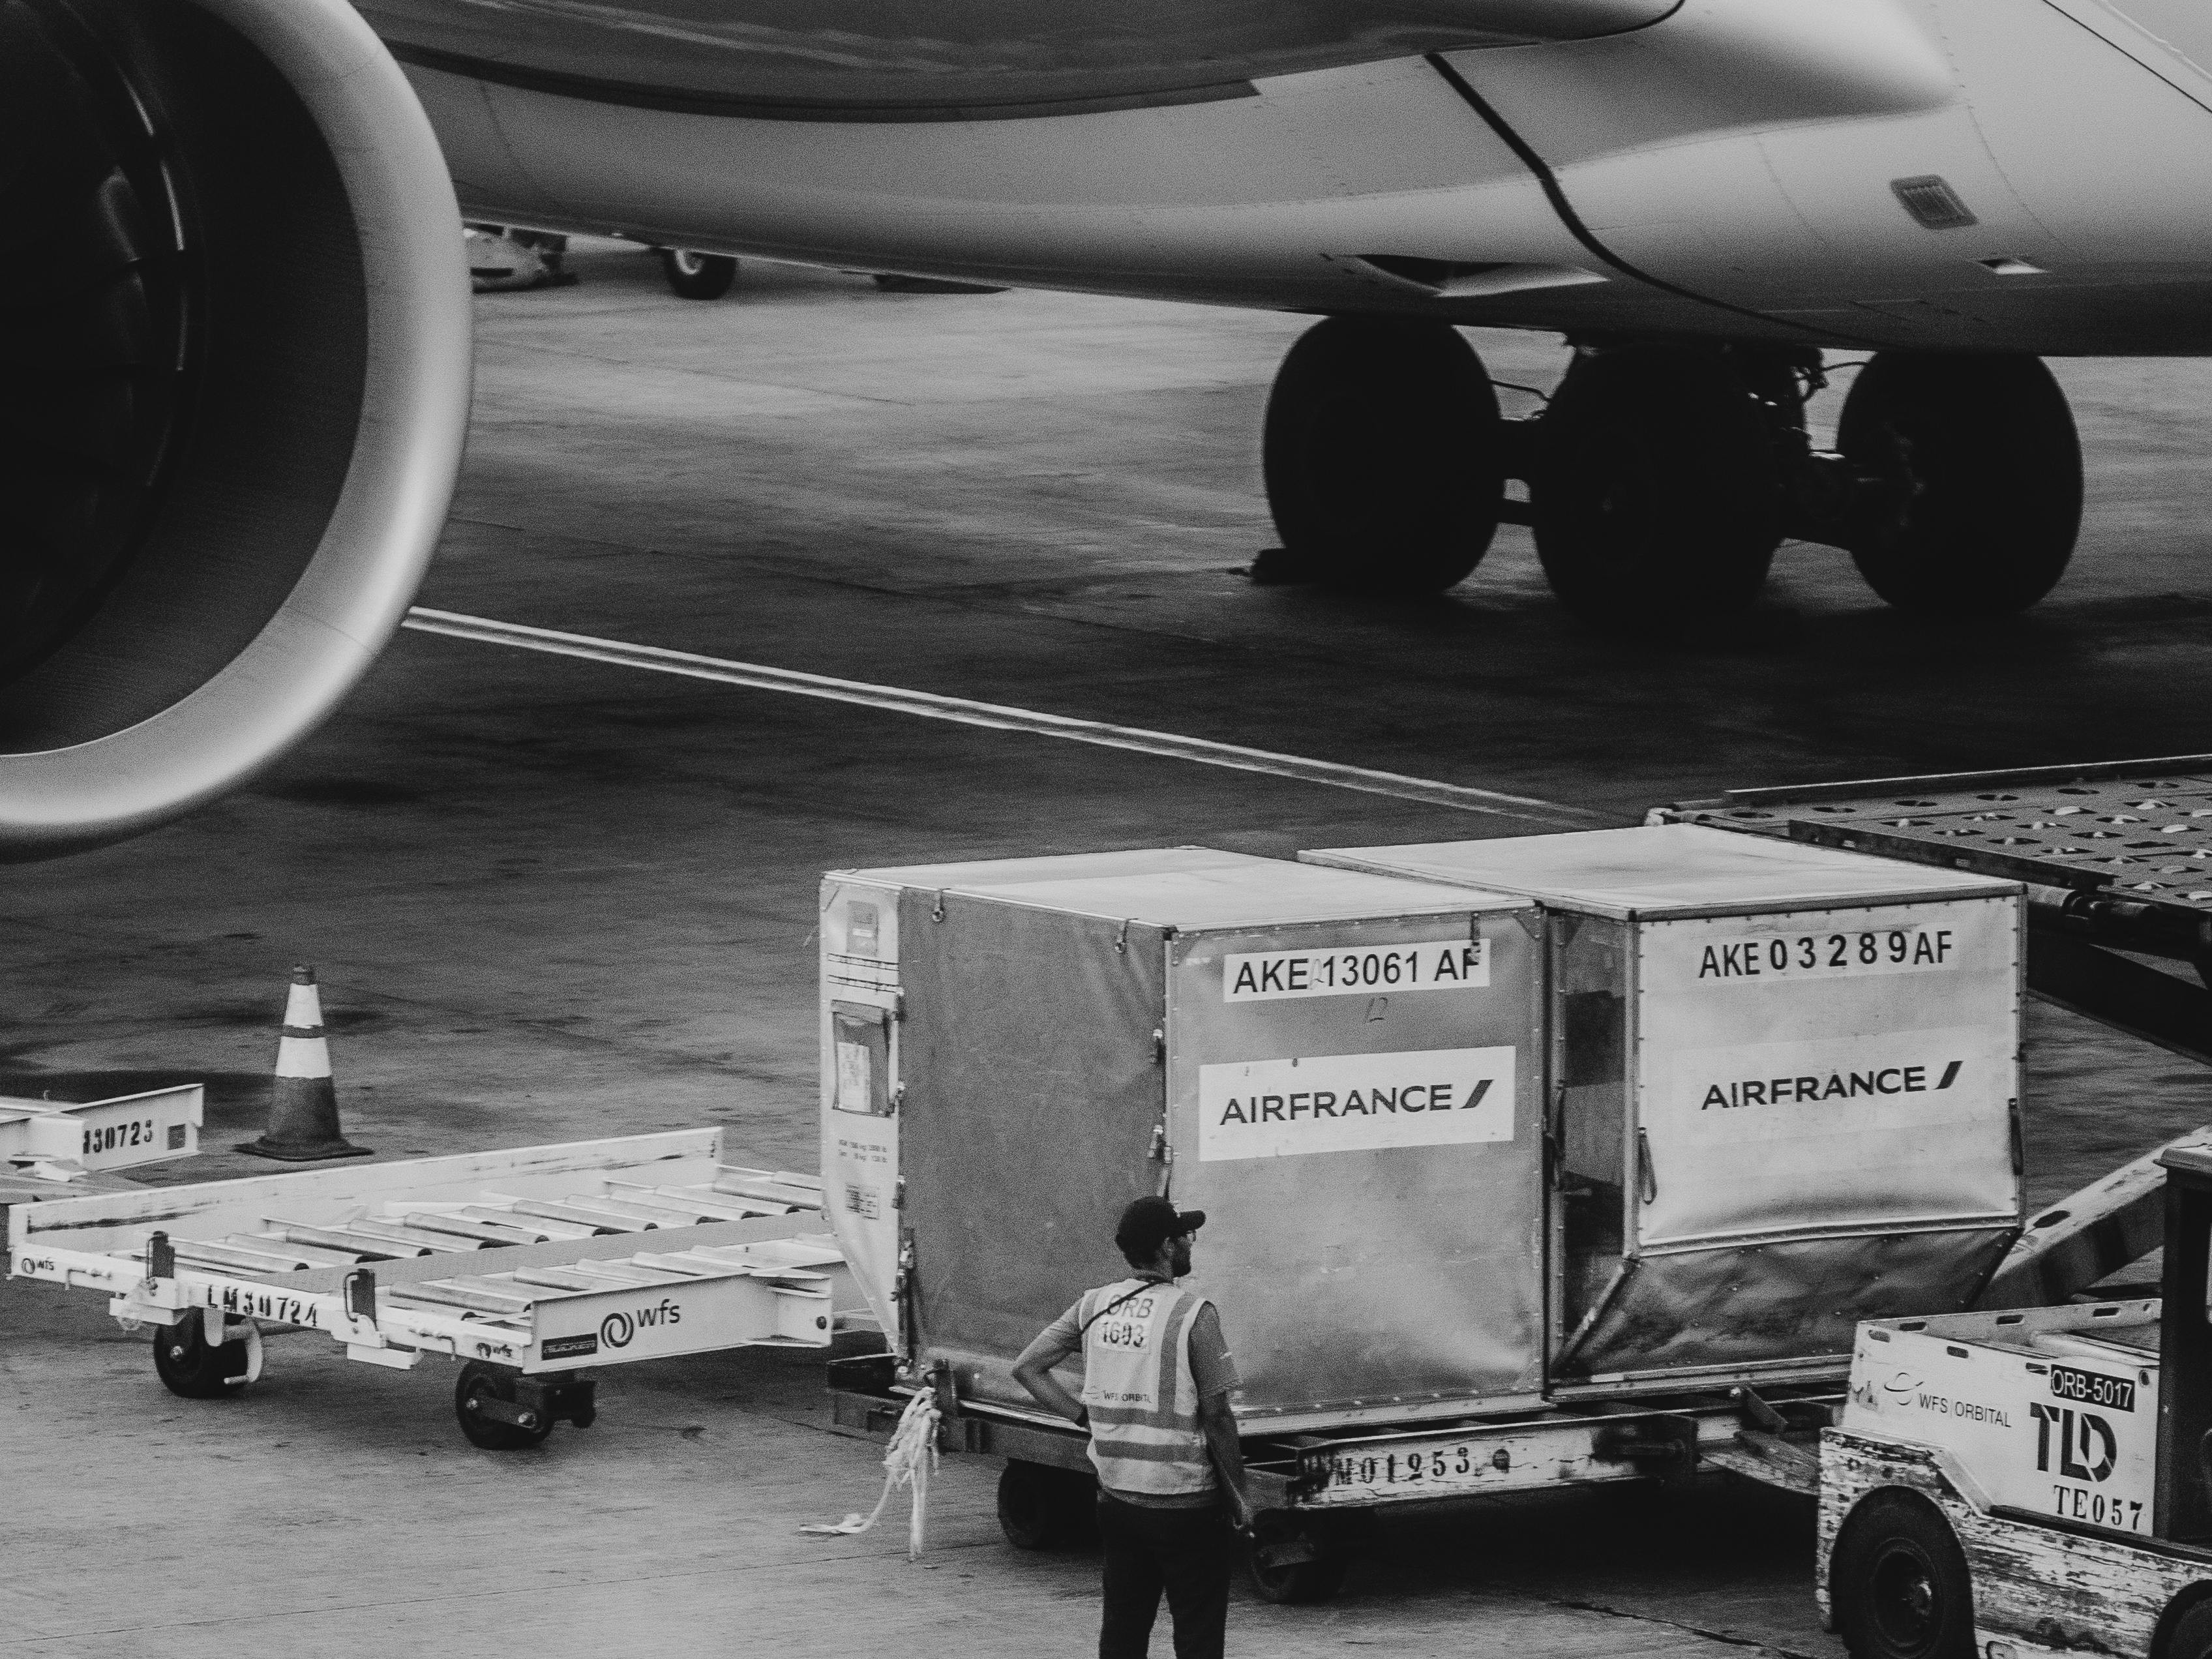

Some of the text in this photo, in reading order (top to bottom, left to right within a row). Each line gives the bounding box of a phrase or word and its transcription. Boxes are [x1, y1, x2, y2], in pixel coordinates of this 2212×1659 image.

[1434, 947, 1480, 981] AF
[1219, 1084, 1452, 1126] AIRFRANCE
[1701, 1066, 1926, 1110] AIRFRANCE
[636, 1298, 680, 1327] wfs
[1108, 1294, 1153, 1318] ORB
[2052, 1369, 2132, 1408] ORB-5017
[1919, 1393, 2012, 1428] WFS ORBITAL
[2030, 1402, 2117, 1482] TLD
[2054, 1485, 2143, 1531] TE057
